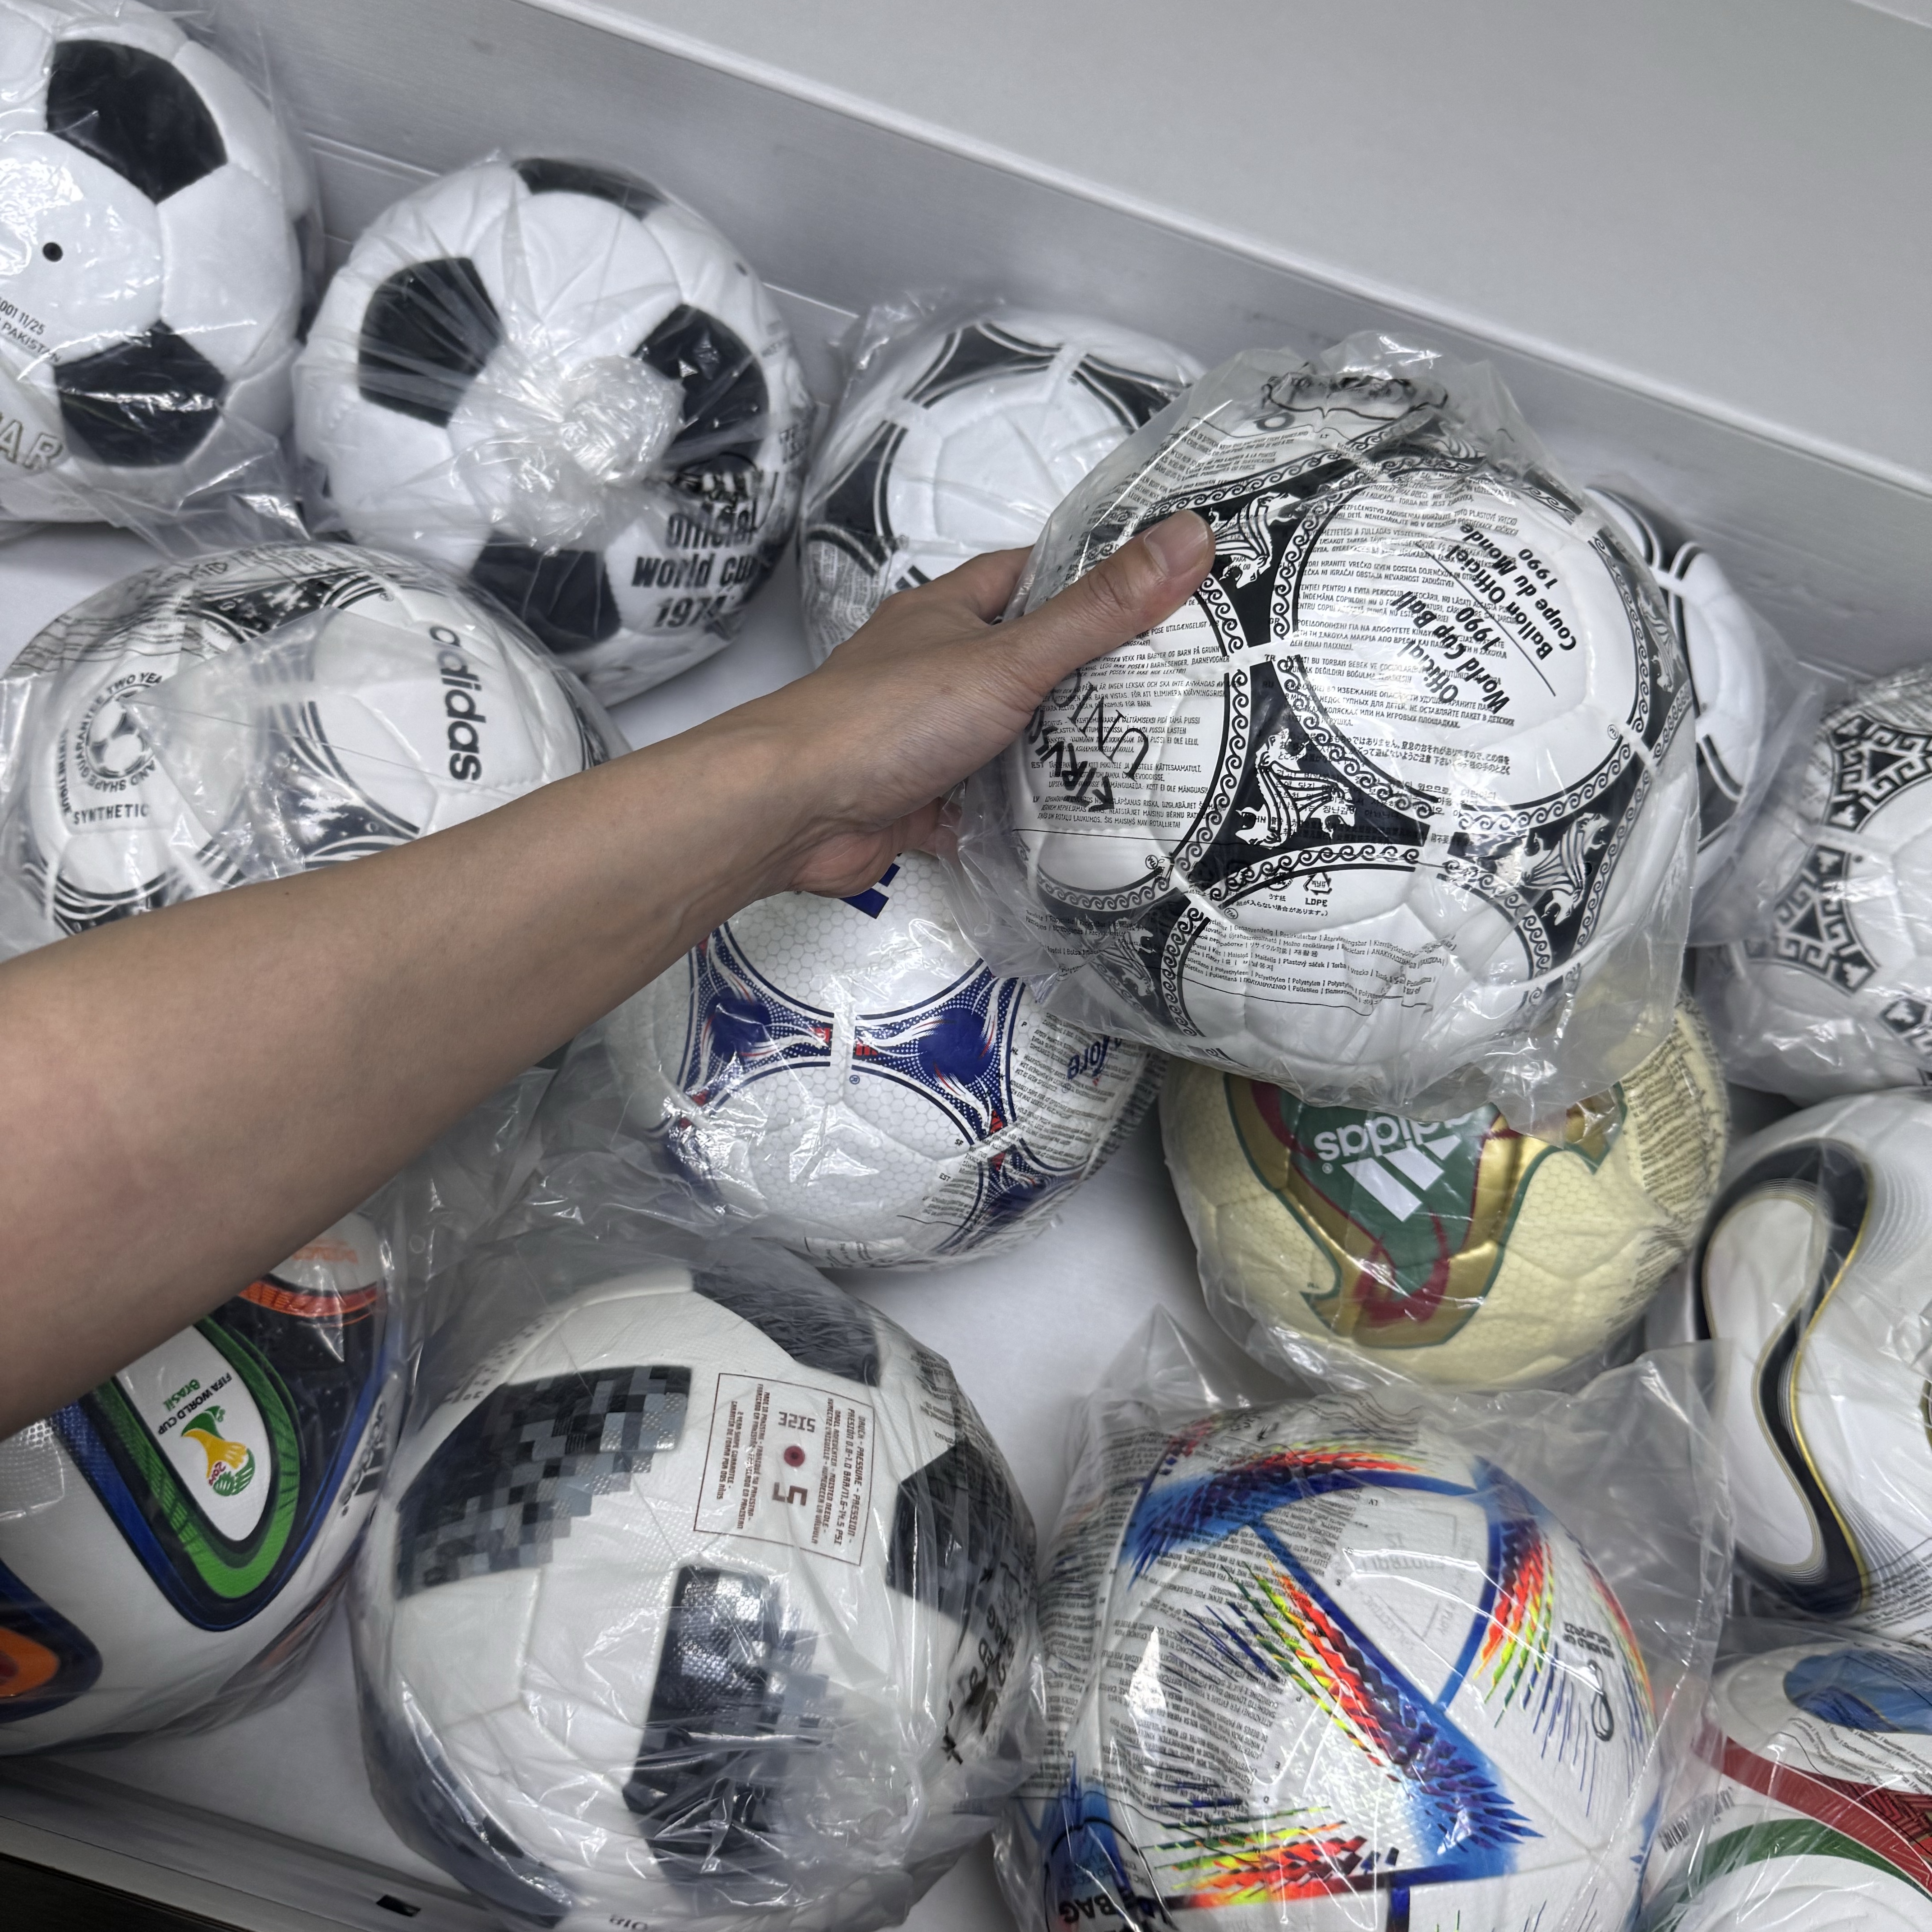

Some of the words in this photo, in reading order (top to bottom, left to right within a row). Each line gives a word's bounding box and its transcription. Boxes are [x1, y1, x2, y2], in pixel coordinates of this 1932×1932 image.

[17, 312, 46, 336] 11/25
[2, 321, 62, 362] PAKISTAN
[1460, 524, 1518, 576] Monde
[1356, 570, 1382, 579] OBSTAJA
[1384, 574, 1419, 583] NEVARNOST
[1393, 565, 1417, 574] DOSEGA
[1444, 544, 1505, 604] Officiel
[1518, 549, 1558, 589] 1990
[1513, 575, 1537, 597] du
[1390, 590, 1436, 629] Ball
[1151, 627, 1164, 635] POSE
[1455, 607, 1501, 650] 1990
[1506, 601, 1553, 660] Ballon
[1535, 598, 1576, 651] Coupe
[1178, 648, 1191, 657] BARN
[1193, 646, 1200, 654] PÅ
[1433, 625, 1464, 660] Cup
[1191, 655, 1230, 666] BARNEVOGNER
[1397, 642, 1459, 704] Official
[139, 672, 163, 685] YEA
[1337, 686, 1378, 697] ИЗБЕЖАНИЕ
[1455, 657, 1510, 715] World
[428, 626, 487, 782] adidas
[74, 803, 150, 825] SYNTHETIC
[1305, 897, 1328, 907] LDPE
[938, 1172, 953, 1182] EST
[210, 1372, 233, 1392] FIFA
[177, 1389, 214, 1420] WORLD
[158, 1417, 178, 1435] CUP
[778, 1411, 816, 1433] SIZE
[727, 1450, 738, 1484] GUARANTEE
[855, 1446, 864, 1486] PRESSURE
[747, 1486, 758, 1517] PAKISTAN
[772, 1481, 809, 1506] 5
[827, 1472, 836, 1502] MOISTEN
[737, 1498, 748, 1529] PAKISTAN
[823, 1502, 833, 1528] NEEDLE
[847, 1493, 860, 1537] PRESSION
[834, 1528, 843, 1546] PSI
[1058, 1894, 1117, 1923] BAG
